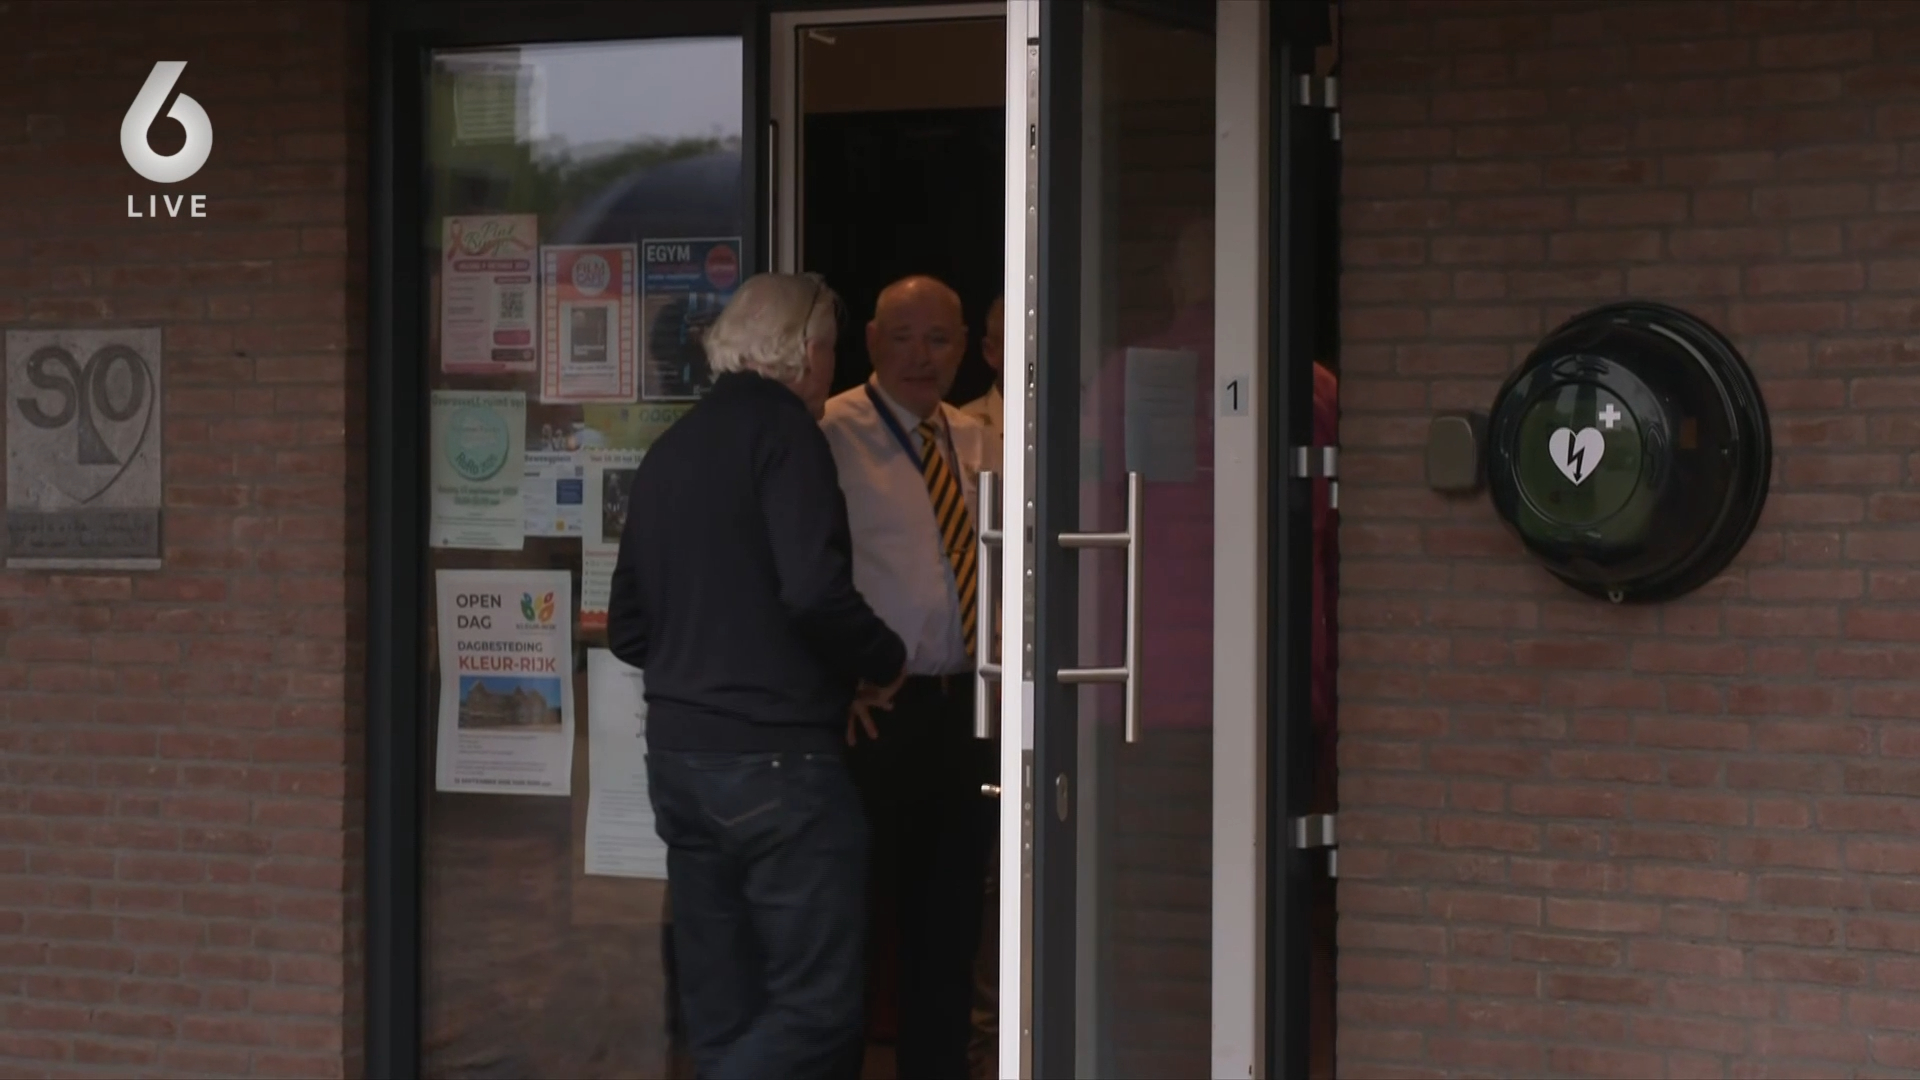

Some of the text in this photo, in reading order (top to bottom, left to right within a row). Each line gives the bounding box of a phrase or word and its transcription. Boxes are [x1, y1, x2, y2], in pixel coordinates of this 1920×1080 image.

[646, 245, 690, 263] EGYM
[1227, 379, 1238, 411] 1
[456, 594, 502, 608] OPEN
[457, 615, 492, 629] DAG
[457, 641, 543, 652] DAGBESTEDING
[459, 656, 556, 672] KLEUR-RIJK
